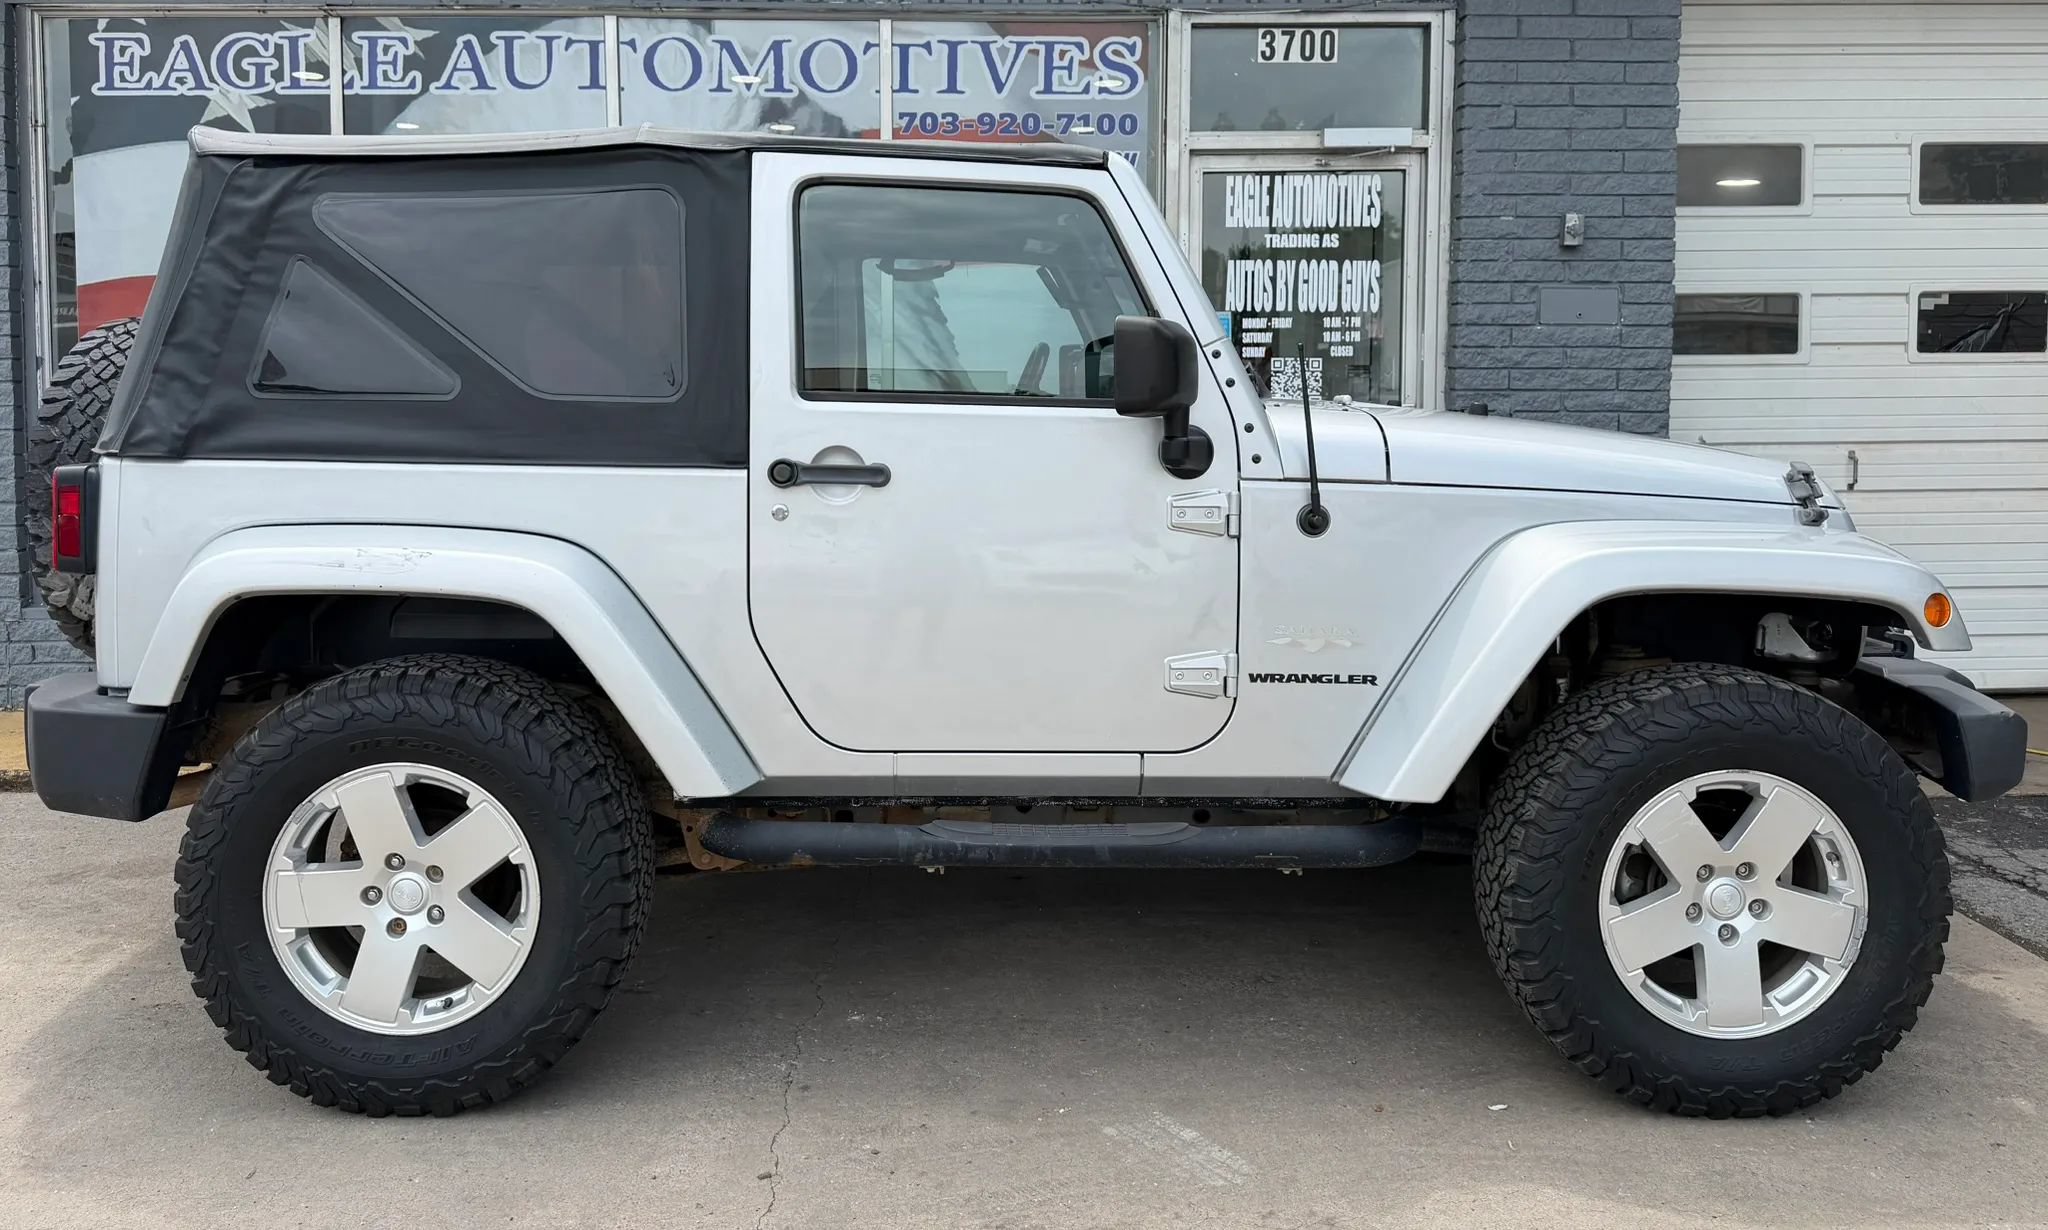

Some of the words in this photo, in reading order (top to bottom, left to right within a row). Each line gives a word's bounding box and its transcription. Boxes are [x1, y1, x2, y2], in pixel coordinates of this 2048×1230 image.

[1260, 29, 1336, 62] 3700
[90, 30, 422, 96] EAGLE
[431, 33, 1143, 99] AUTOMOTIVES
[898, 111, 1140, 137] 703-920-7100
[1225, 174, 1270, 228] EAGLE
[1272, 174, 1381, 228] AUTOMOTIVES
[1264, 233, 1320, 248] TRADING
[1321, 233, 1339, 248] AS
[1225, 259, 1273, 313] AUTOS
[1276, 260, 1296, 312] BY
[1298, 259, 1338, 313] GOOD
[1341, 259, 1380, 313] GUYS
[1242, 317, 1267, 329] MONDAY
[1272, 317, 1293, 329] FRIDAY
[1242, 332, 1273, 344] SATURDAY
[1242, 346, 1266, 358] SUNDAY
[1330, 345, 1354, 357] CLOSED
[1248, 673, 1379, 686] WRANGLER
